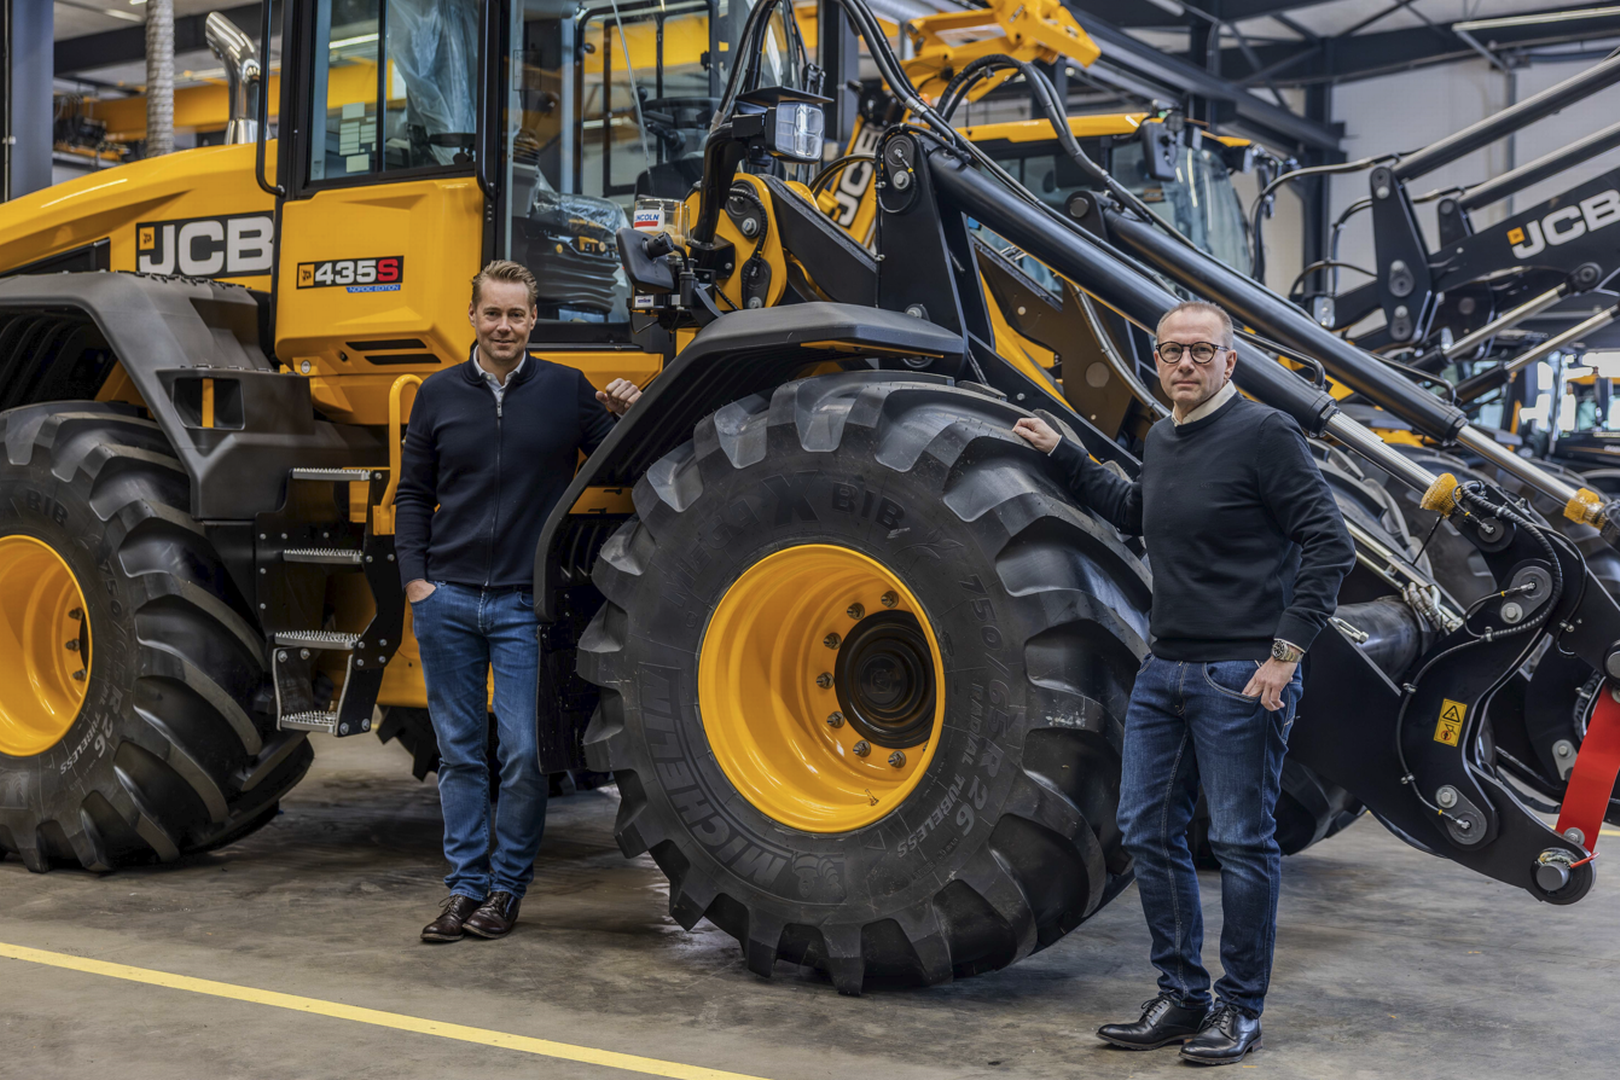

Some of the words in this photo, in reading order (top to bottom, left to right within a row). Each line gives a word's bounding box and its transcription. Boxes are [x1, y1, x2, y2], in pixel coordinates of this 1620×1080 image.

[139, 216, 273, 276] JCB
[1512, 189, 1620, 259] JCB
[315, 258, 399, 285] 435S
[374, 284, 400, 292] EDITION
[26, 487, 69, 527] BIB
[59, 711, 101, 776] TUBELESS
[962, 682, 984, 766] RADIAL
[641, 666, 788, 889] MICHELIN
[897, 773, 967, 859] TUBELESS
